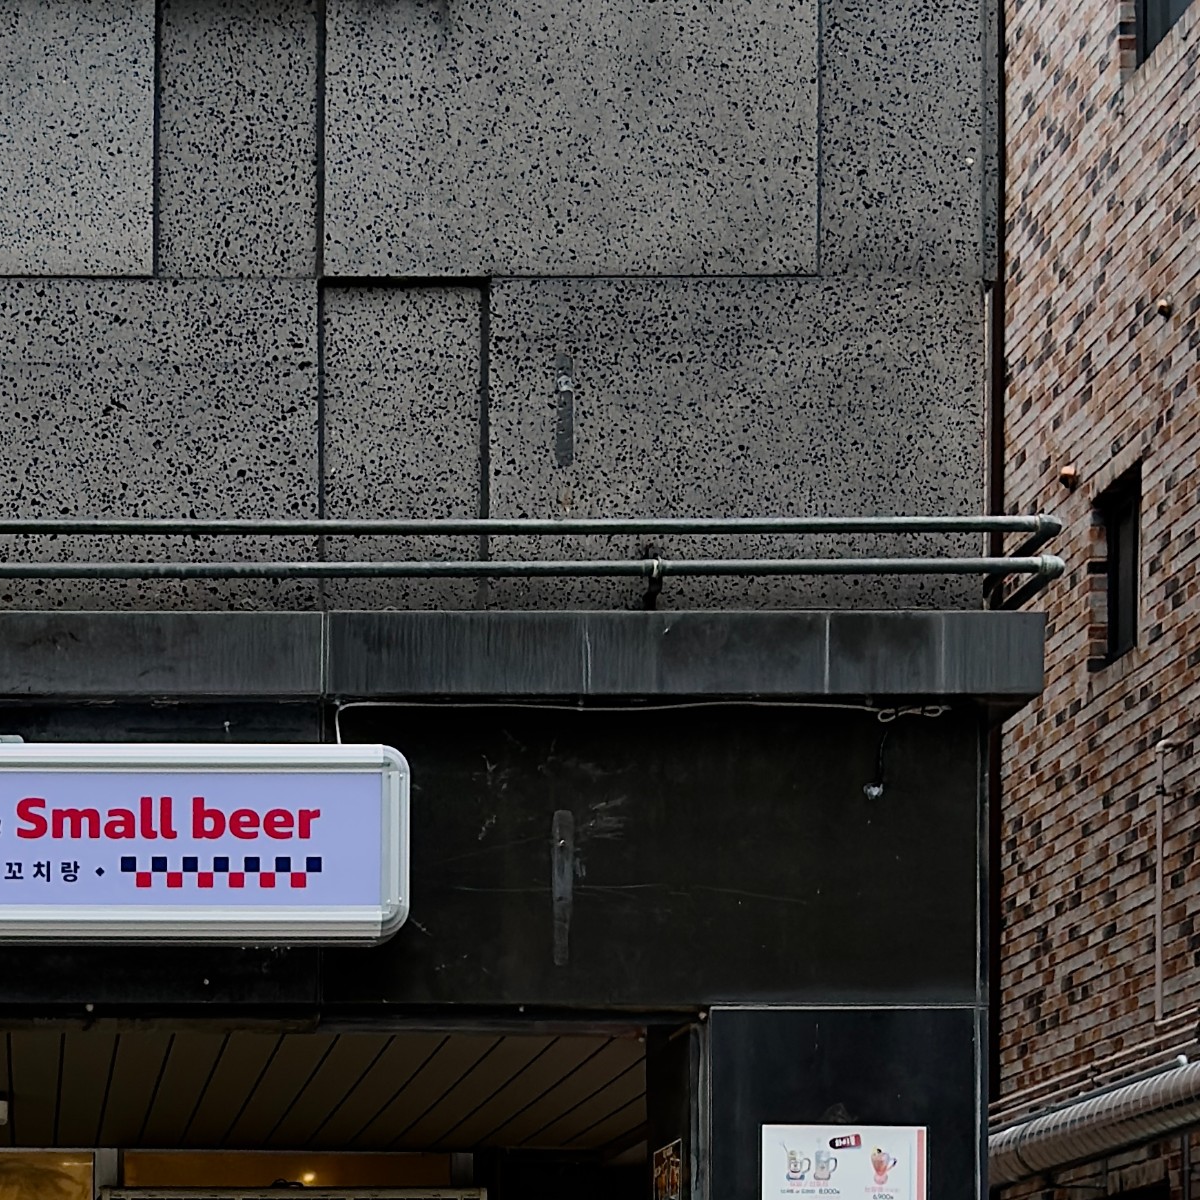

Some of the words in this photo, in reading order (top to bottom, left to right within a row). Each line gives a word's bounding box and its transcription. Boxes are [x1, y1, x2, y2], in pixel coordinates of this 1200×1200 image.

[16, 796, 177, 839] Small
[192, 797, 321, 840] beer
[4, 861, 81, 883] 꼬치랑
